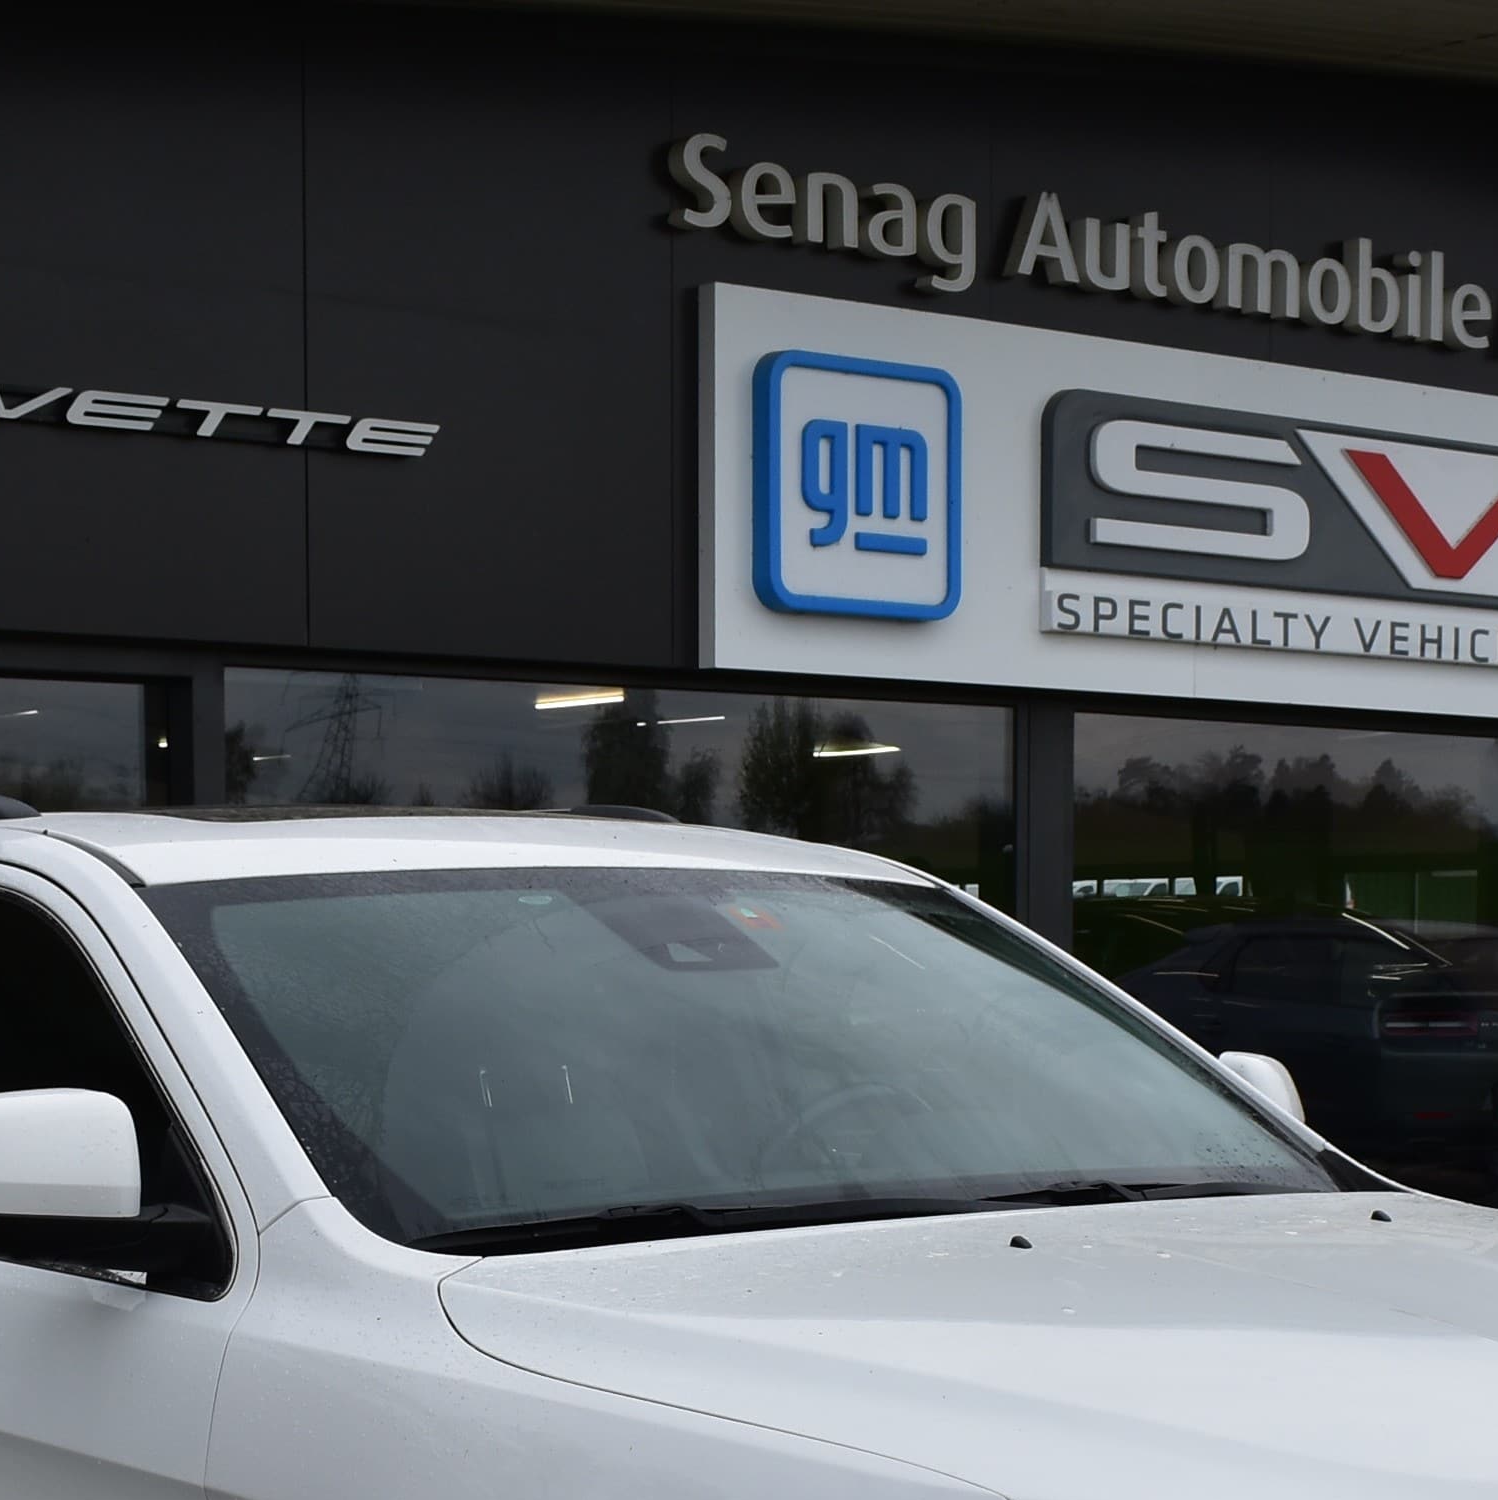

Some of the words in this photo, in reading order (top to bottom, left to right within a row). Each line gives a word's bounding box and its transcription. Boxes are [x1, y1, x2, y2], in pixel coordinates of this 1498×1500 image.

[673, 132, 977, 292] Senag
[1008, 191, 1493, 350] Automobile
[800, 418, 929, 549] gm
[1055, 591, 1331, 651] SPECIALTY
